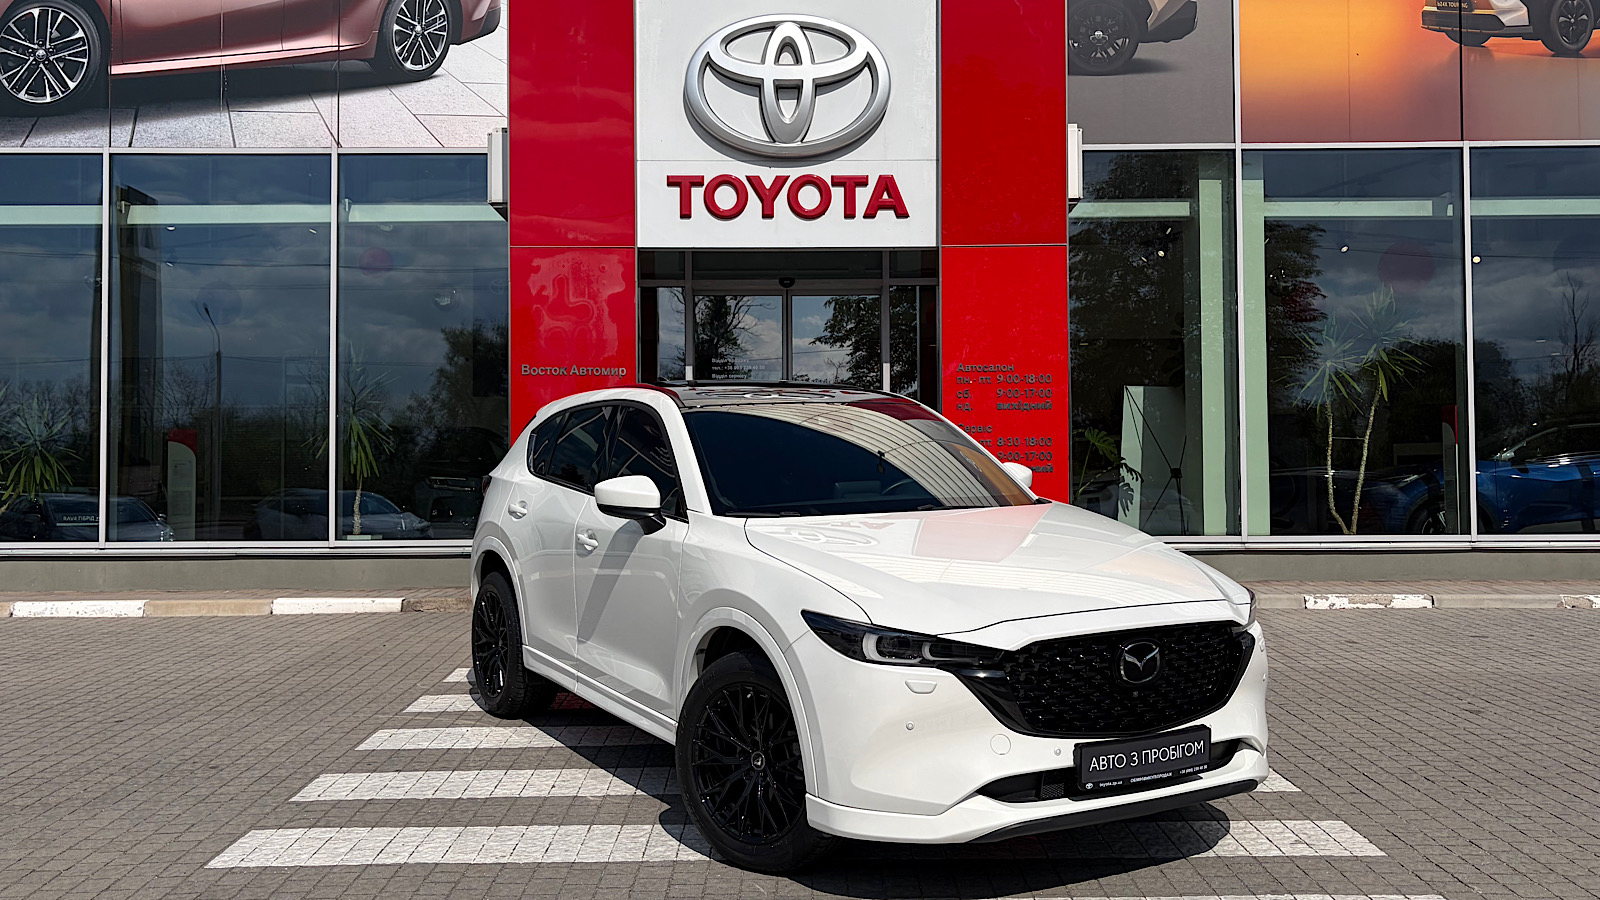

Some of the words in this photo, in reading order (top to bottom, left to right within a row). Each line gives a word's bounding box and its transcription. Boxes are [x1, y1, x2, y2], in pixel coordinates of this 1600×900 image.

[1448, 1, 1469, 9] TOURNG
[667, 174, 910, 221] TOYOTA
[521, 364, 567, 376] Восток
[570, 364, 627, 379] Автомир
[956, 363, 1015, 373] Автосалон
[996, 374, 1052, 385] 9:00-18:00
[956, 389, 973, 399] сб.
[996, 388, 1053, 398] 9:00-17:00
[956, 402, 973, 411] нд.
[996, 400, 1053, 412] вихідний
[997, 437, 1053, 447] 8:30-18:00
[997, 452, 1053, 461] 9:00-17:00
[1089, 754, 1126, 772] АВТО
[1142, 740, 1204, 765] ПРОБІГОМ
